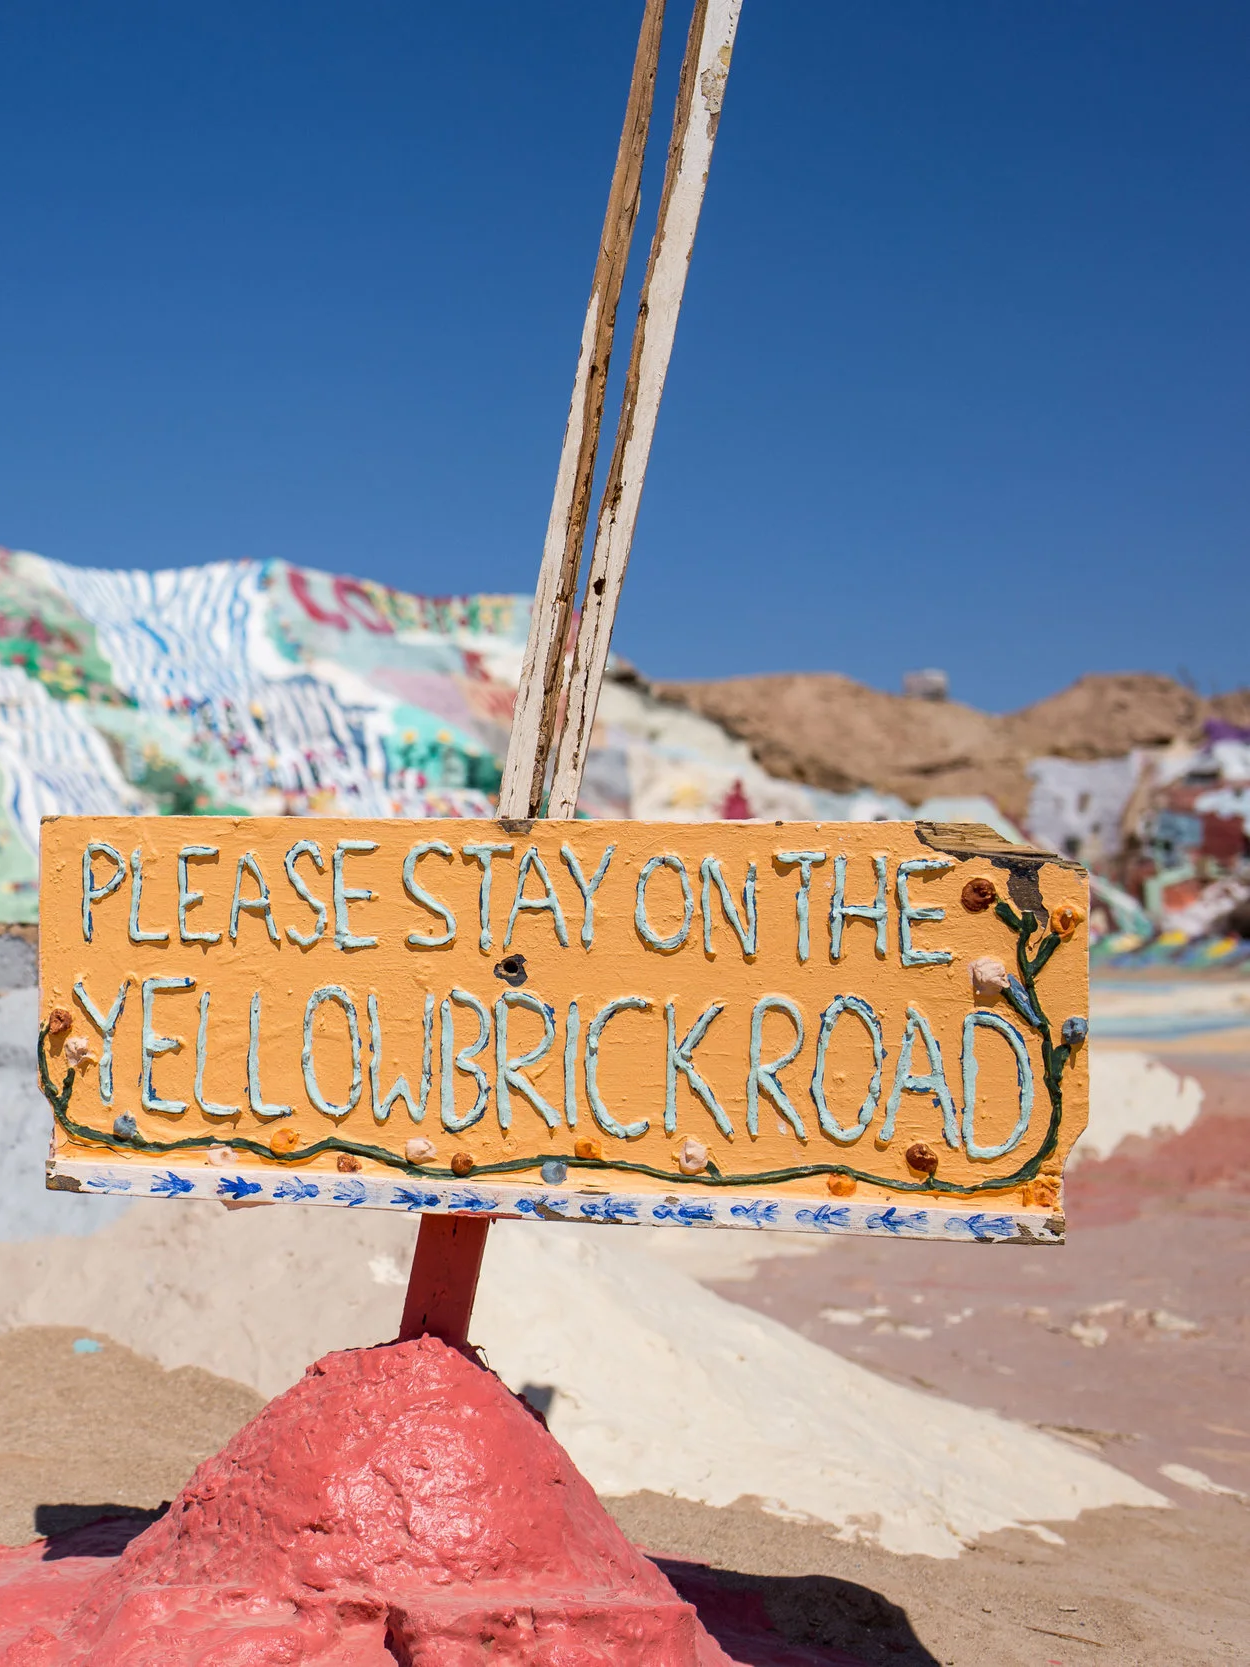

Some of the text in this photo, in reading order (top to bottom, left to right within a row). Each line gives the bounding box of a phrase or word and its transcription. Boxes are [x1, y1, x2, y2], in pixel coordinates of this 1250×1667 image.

[81, 839, 953, 967] PLEASE STAY ON THE
[73, 976, 1034, 1161] YELLOW BRICK ROAD
